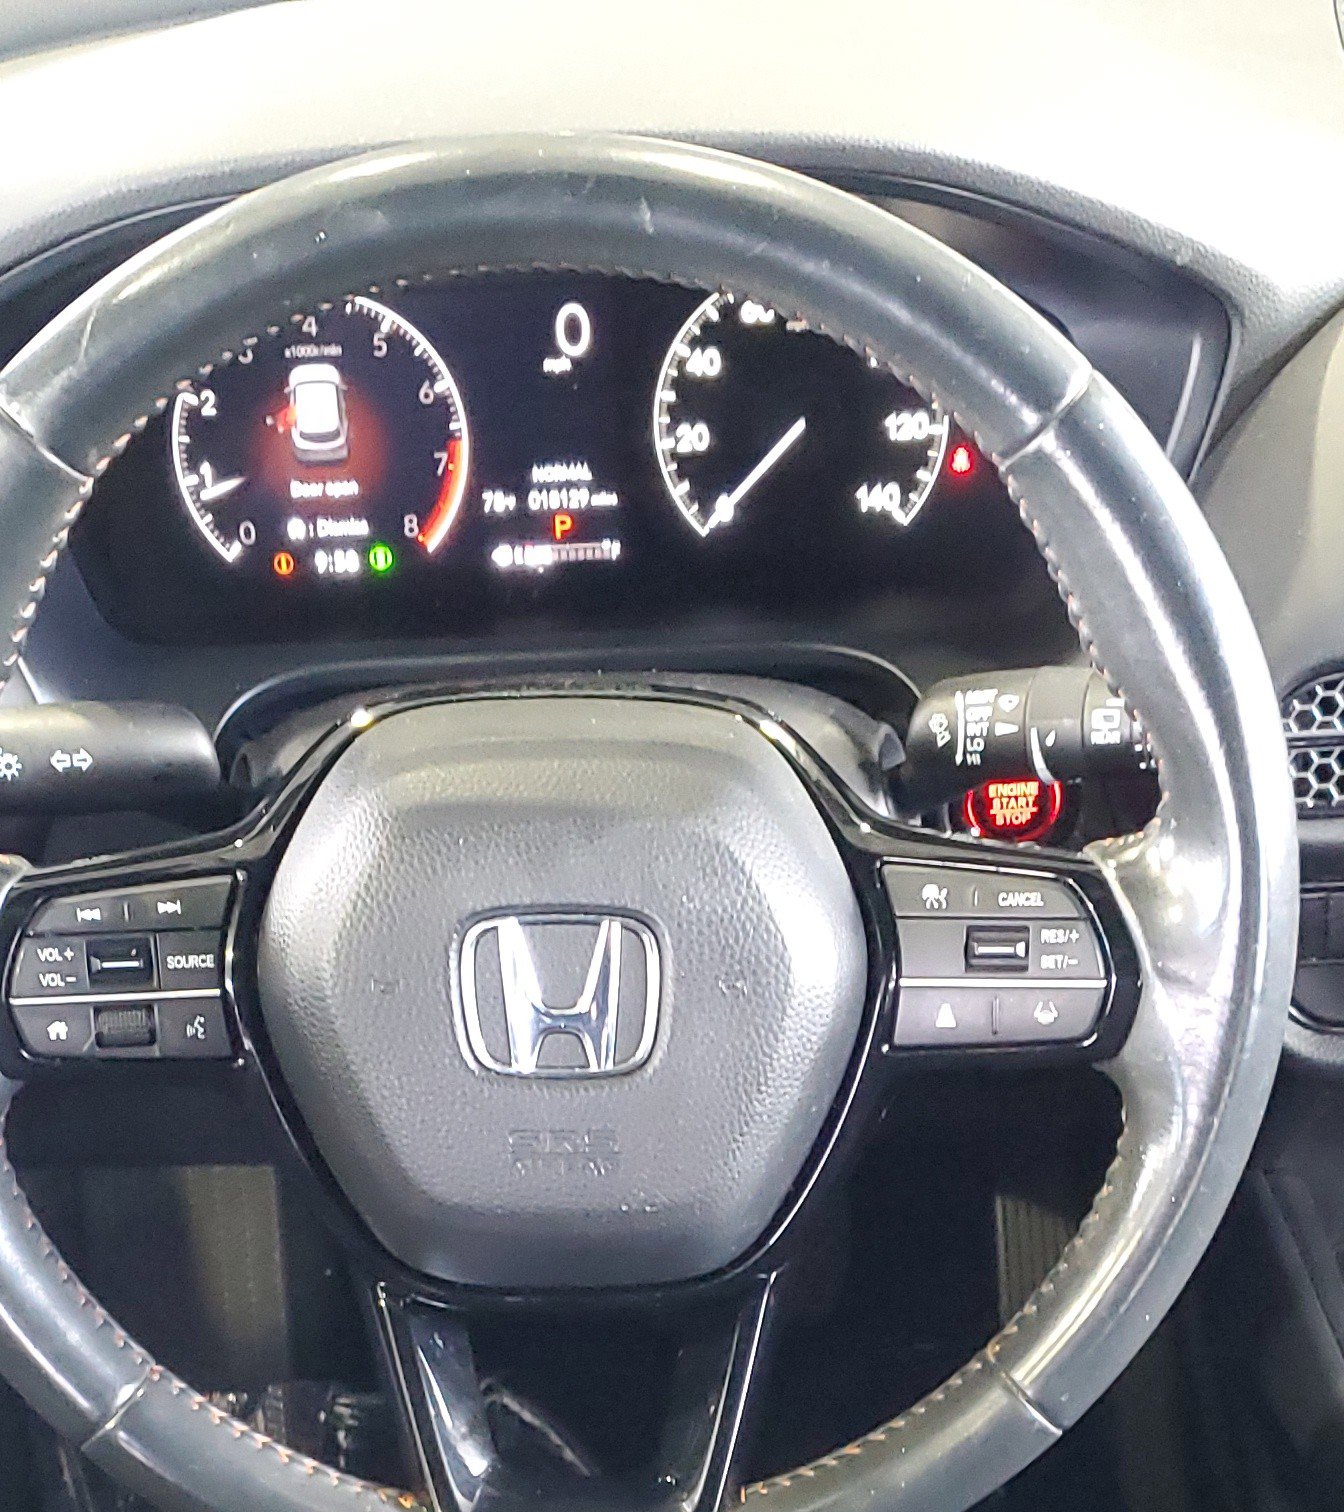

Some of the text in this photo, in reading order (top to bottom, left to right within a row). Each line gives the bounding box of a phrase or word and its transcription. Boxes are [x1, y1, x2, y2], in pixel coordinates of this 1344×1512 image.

[302, 316, 318, 337] 4
[555, 302, 591, 356] 0
[373, 333, 387, 357] 5
[686, 346, 722, 377] 40
[199, 389, 217, 416] 2
[419, 380, 434, 404] 6
[676, 423, 710, 452] 20
[884, 412, 929, 441] 120
[433, 452, 447, 476] 7
[856, 482, 901, 513] 140
[239, 520, 256, 545] 0
[403, 514, 419, 537] 8
[554, 512, 573, 540] P
[966, 738, 984, 751] LO
[966, 753, 981, 766] HI
[989, 782, 1039, 798] ENGINE
[993, 796, 1035, 809] START
[996, 811, 1031, 825] STOP
[998, 892, 1044, 907] CANCEL
[37, 947, 62, 962] VOL
[166, 954, 215, 969] SOURCE
[39, 973, 64, 987] VOL
